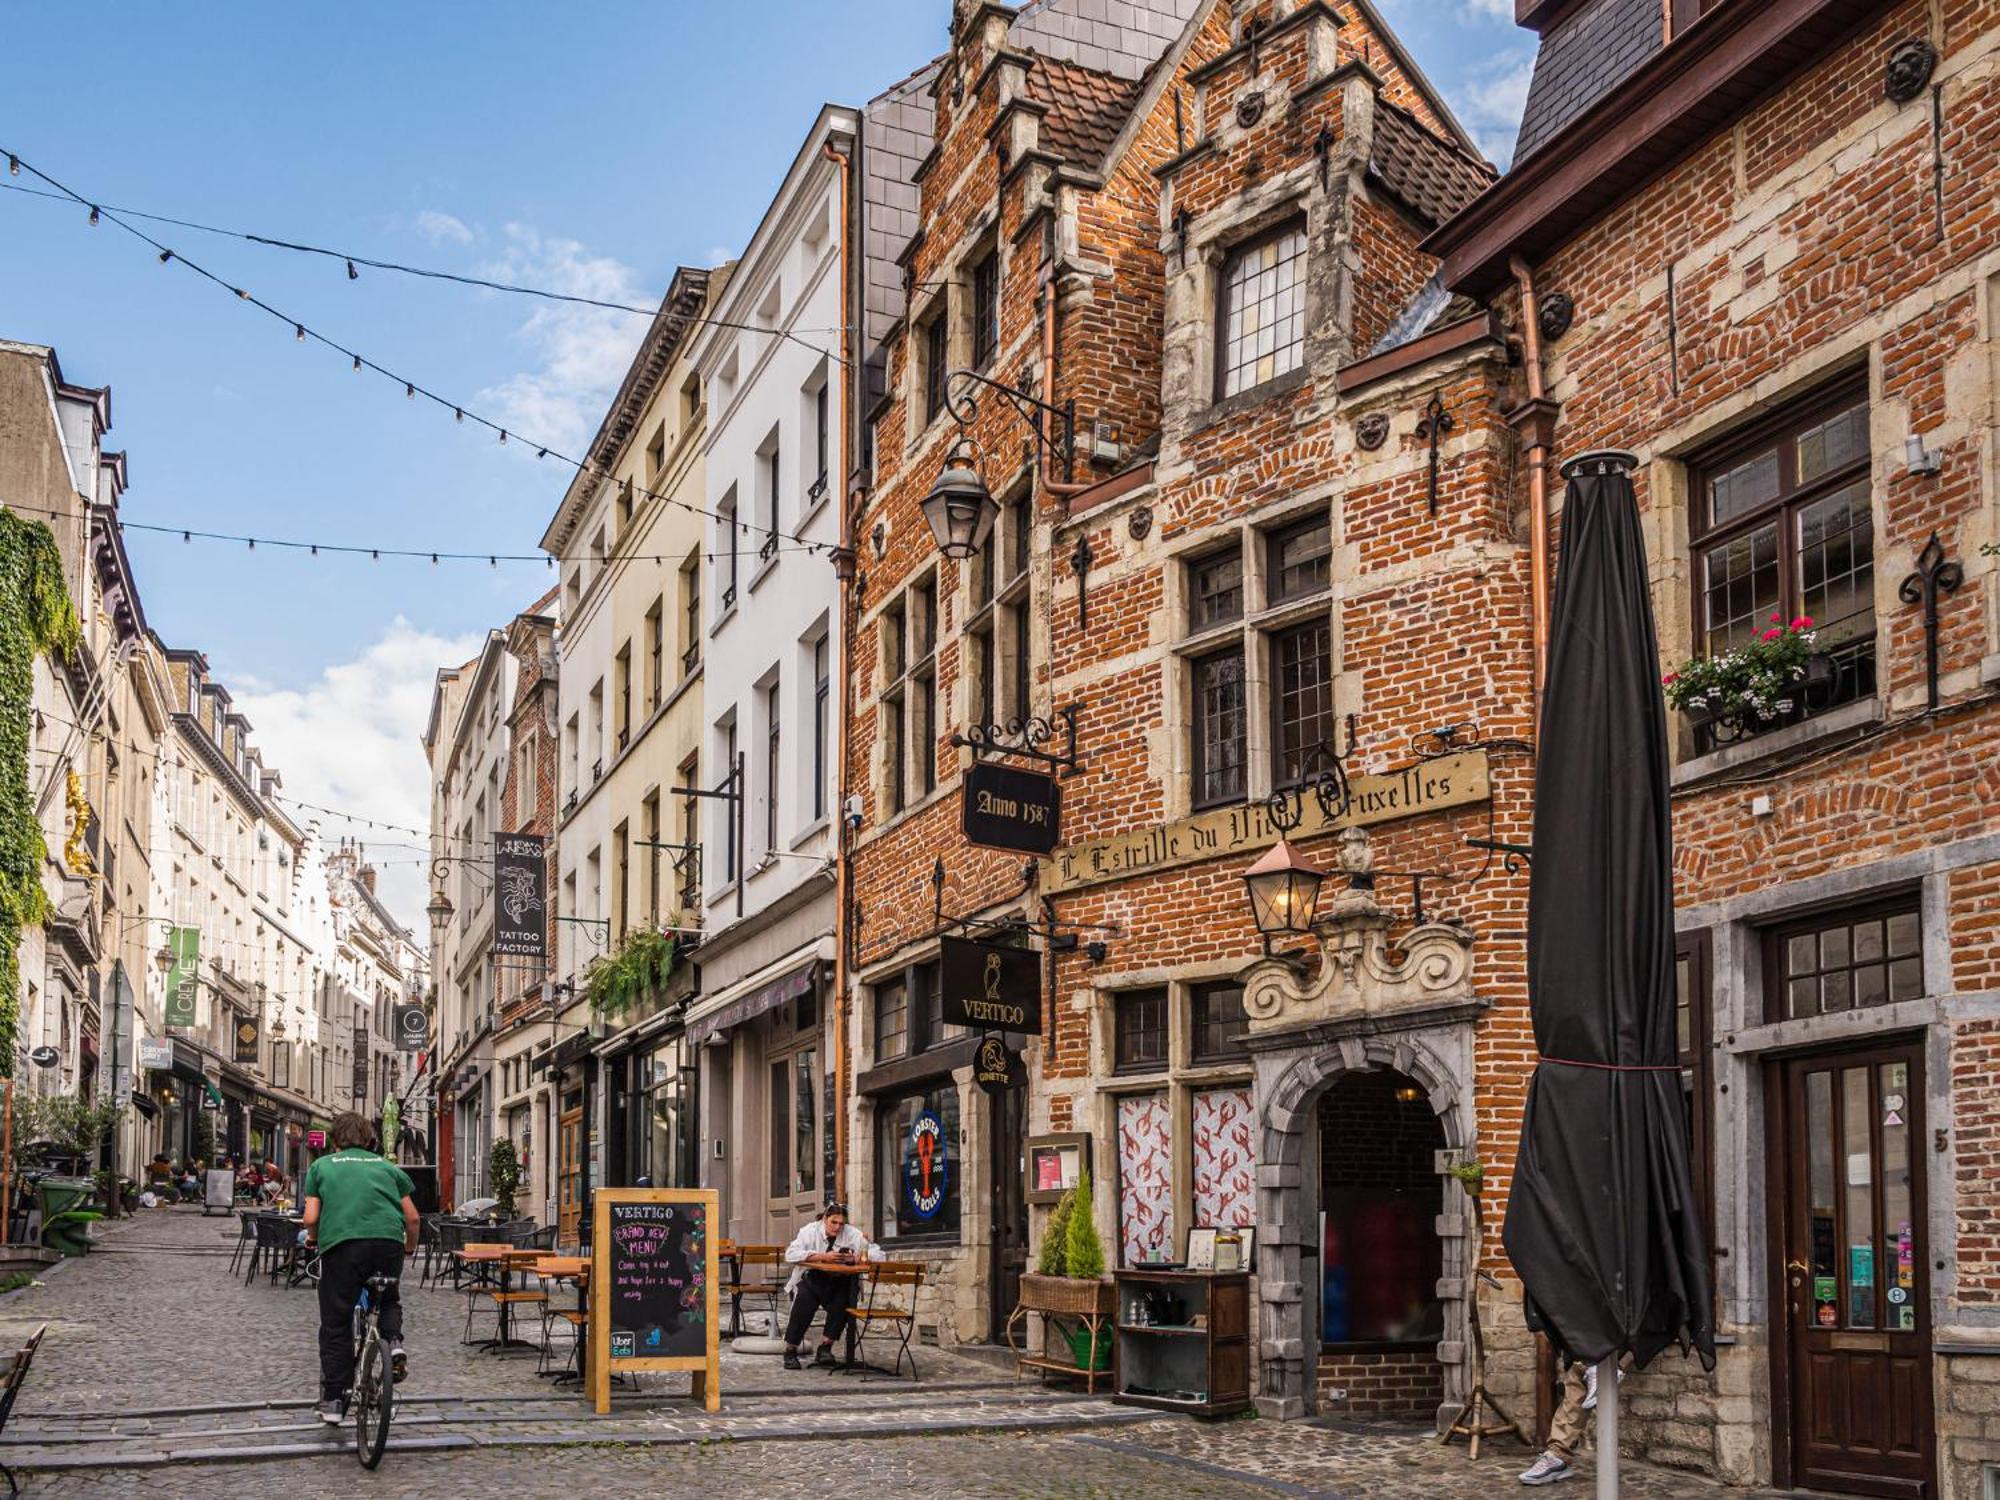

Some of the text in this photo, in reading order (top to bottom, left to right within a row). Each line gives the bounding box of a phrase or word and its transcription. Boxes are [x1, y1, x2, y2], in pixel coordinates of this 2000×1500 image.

[977, 790, 1050, 828] Anno 1587
[1189, 825, 1218, 851] du
[499, 930, 540, 941] TATTOO
[497, 943, 542, 954] FACTORY
[962, 999, 1024, 1025] VERTIGO
[912, 1117, 940, 1143] LOBSTER
[1934, 1128, 1949, 1153] 5
[1443, 1151, 1455, 1170] 7
[920, 1186, 941, 1212] ROLLS
[614, 1207, 674, 1219] VERTIGO
[648, 1227, 666, 1239] NEW
[629, 1239, 657, 1256] MENU
[612, 1336, 632, 1346] Uber
[612, 1346, 631, 1356] Eats
